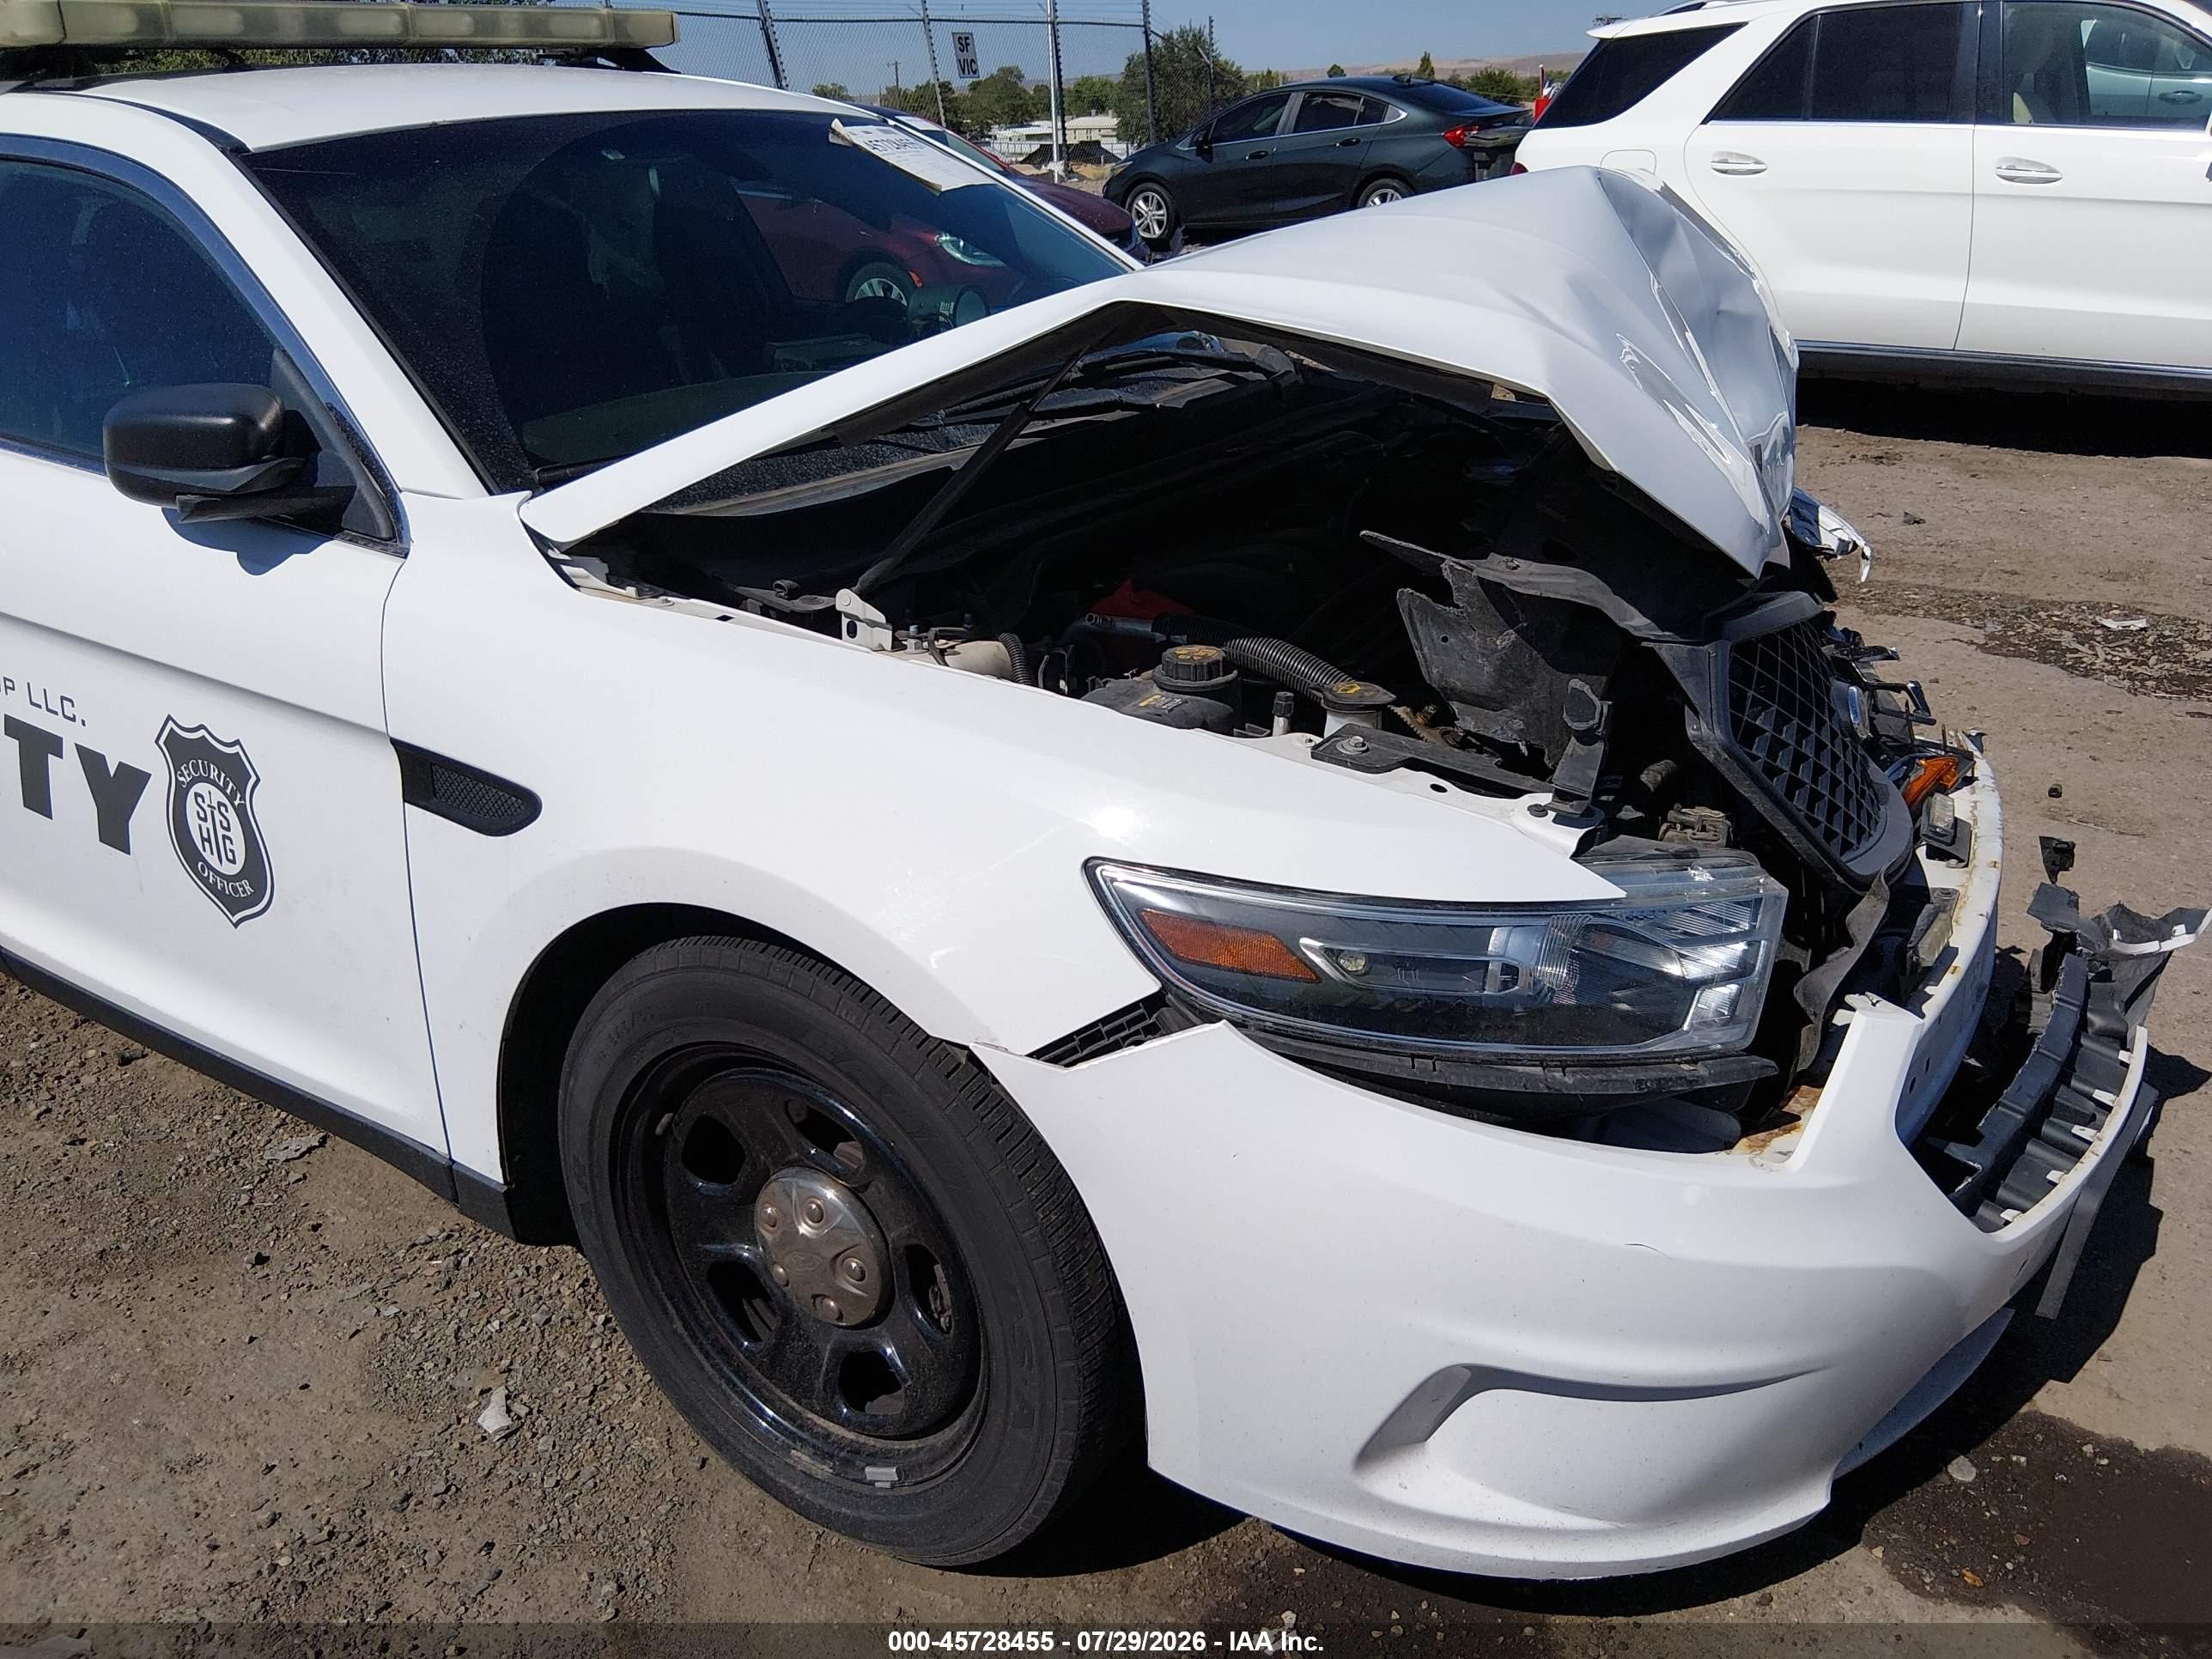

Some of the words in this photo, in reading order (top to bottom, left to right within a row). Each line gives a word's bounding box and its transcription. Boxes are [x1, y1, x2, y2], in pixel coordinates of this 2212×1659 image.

[957, 36, 970, 53] SF
[958, 58, 977, 75] VIC
[27, 681, 87, 727] LLC.
[3, 714, 153, 856] TY
[176, 758, 246, 808] SECURITY
[198, 860, 255, 898] OFFICER
